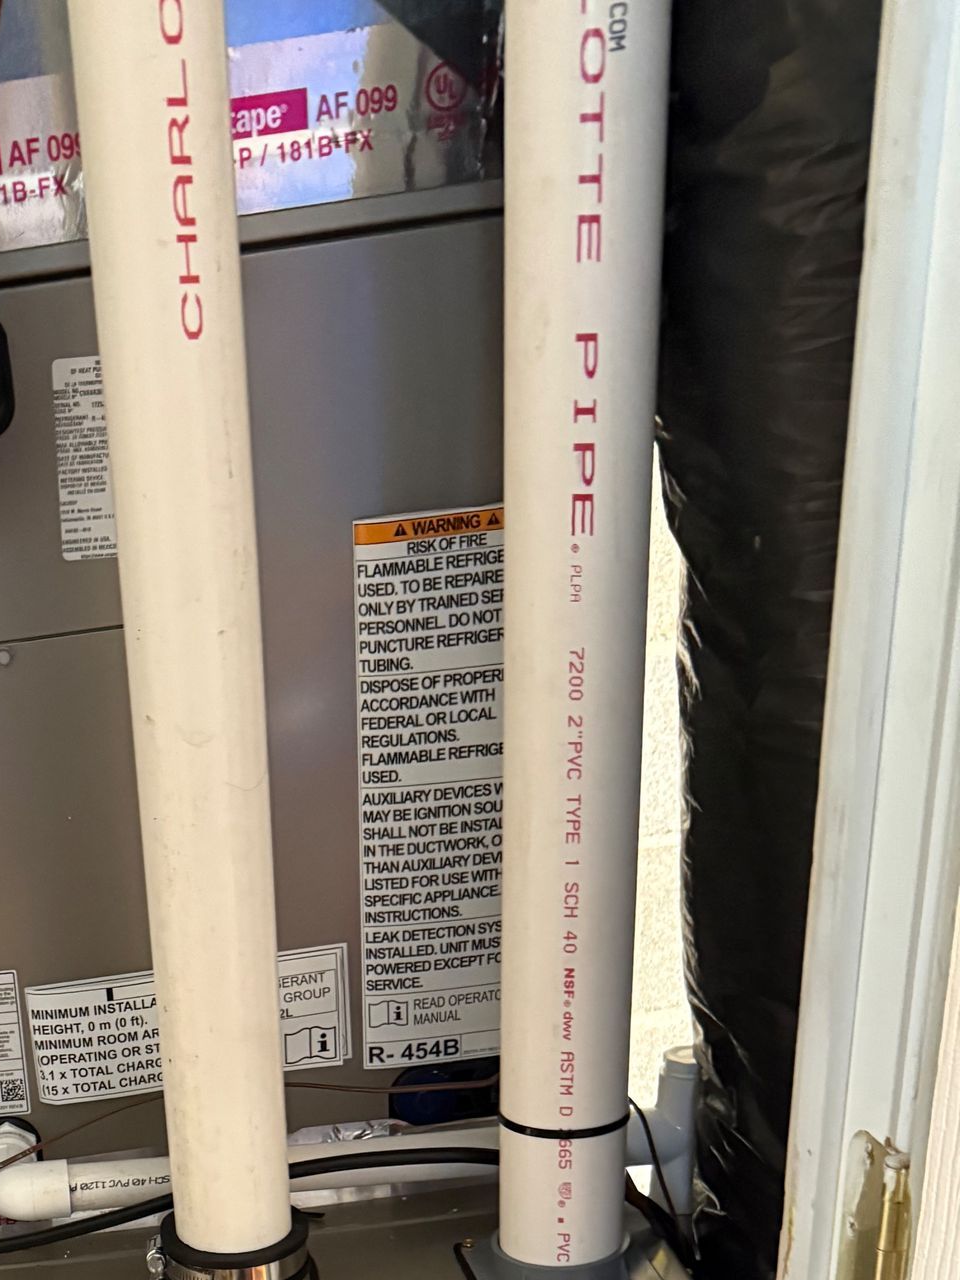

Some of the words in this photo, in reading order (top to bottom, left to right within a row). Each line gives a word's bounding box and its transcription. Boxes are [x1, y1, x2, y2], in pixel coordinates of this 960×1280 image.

[317, 91, 349, 122] AF
[356, 84, 397, 117] 099
[577, 0, 606, 263] OTTE
[9, 138, 40, 168] AF
[277, 129, 374, 164] 181B-FX
[571, 333, 599, 536] PIPE
[412, 514, 481, 535] WARNING
[407, 539, 437, 555] RISK
[439, 537, 457, 551] OF
[459, 533, 488, 549] FIRE
[357, 557, 444, 578] FLAMMABLE
[358, 582, 398, 598] USED.
[401, 580, 420, 594] TO
[423, 576, 442, 592] BE
[570, 564, 582, 602] PLPA
[358, 602, 394, 617] ONLY
[396, 599, 417, 614] BY
[419, 592, 479, 611] TRAINED
[449, 612, 470, 627] DO
[473, 609, 502, 625] NOT
[359, 635, 434, 654] PUNCTURE
[359, 657, 414, 673] TUBING.
[569, 647, 585, 701] 7200
[360, 677, 419, 694] DISPOSE
[421, 675, 441, 690] OF
[361, 692, 458, 713] ACCORDANCE
[460, 688, 496, 704] WITH
[361, 715, 424, 731] FEDERAL
[426, 711, 447, 726] OR
[449, 707, 497, 724] LOCAL
[362, 729, 460, 748] REGULATIONS.
[362, 748, 446, 766] FLAMMABLE
[362, 770, 402, 784] USED.
[363, 789, 432, 806] AUXILIARY
[434, 783, 493, 801] DEVICES
[363, 810, 391, 824] MAY
[393, 807, 412, 822] BE
[414, 802, 471, 821] IGNITION
[565, 794, 581, 844] TYPE
[363, 827, 406, 841] SHALL
[409, 823, 437, 838] NOT
[439, 821, 458, 836] BE
[363, 845, 376, 858] IN
[378, 842, 405, 857] THE
[407, 836, 489, 856] DUCTWORK,
[364, 860, 400, 875] THAN
[401, 855, 471, 873] AUXILIARY
[365, 877, 409, 891] LISTED
[411, 875, 439, 889] FOR
[441, 871, 469, 885] USE
[365, 893, 422, 908] SPECIFIC
[563, 882, 579, 919] SCH
[365, 905, 463, 924] INSTRUCTIONS.
[365, 931, 401, 944] LEAK
[402, 923, 476, 942] DETECTION
[563, 931, 578, 955] 40
[365, 944, 438, 960] INSTALLED.
[440, 940, 470, 954] UNIT
[366, 960, 432, 976] POWERED
[434, 954, 485, 970] EXCEPT
[366, 977, 424, 991] SERVICE.
[563, 968, 576, 999] NSF
[283, 986, 331, 1003] GROUP
[414, 996, 445, 1010] READ
[31, 1006, 90, 1020] MINIMUM
[414, 1010, 461, 1026] MANUAL
[32, 1022, 85, 1036] HEIGHT,
[88, 1021, 95, 1032] 0
[99, 1021, 111, 1030] m
[115, 1018, 127, 1031] (0
[562, 1011, 575, 1041] dwv
[34, 1037, 93, 1051] MINIMUM
[97, 1031, 139, 1046] ROOM
[401, 1038, 460, 1061] 454B
[121, 1046, 141, 1058] OR
[59, 1071, 67, 1080] x
[70, 1065, 114, 1079] TOTAL
[559, 1051, 575, 1096] ASTM
[62, 1086, 69, 1095] x
[72, 1080, 116, 1093] TOTAL
[559, 1106, 573, 1117] D
[557, 1233, 571, 1263] PVC
